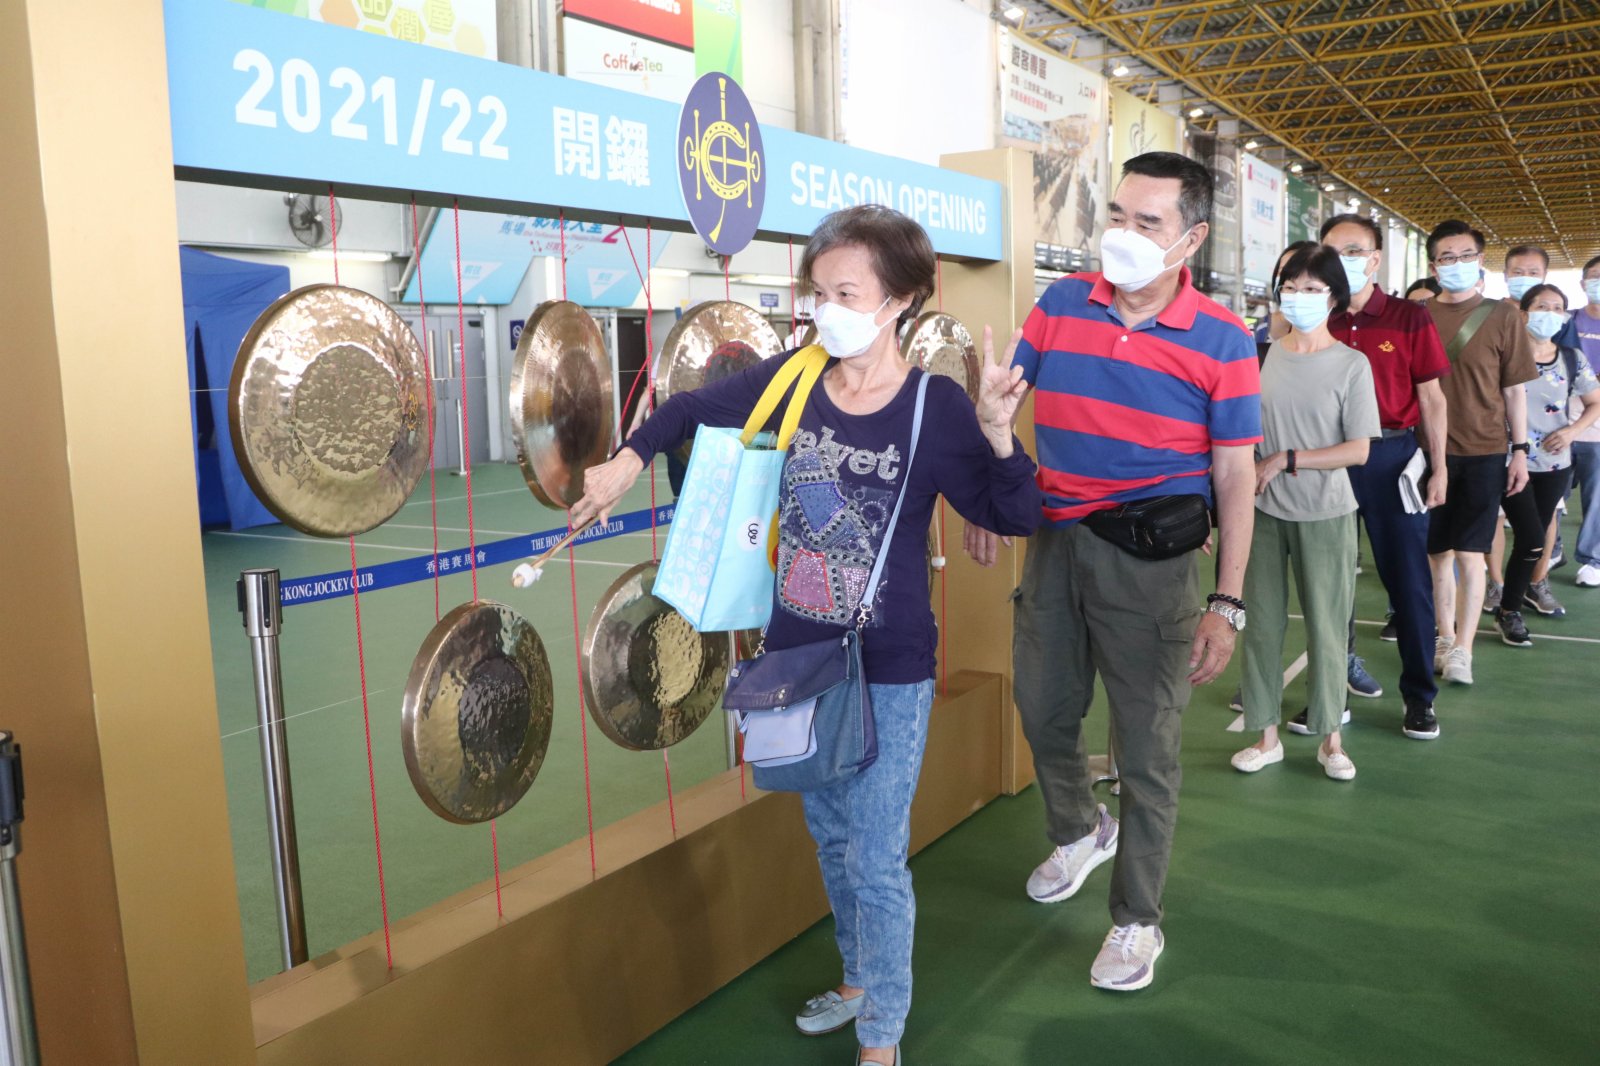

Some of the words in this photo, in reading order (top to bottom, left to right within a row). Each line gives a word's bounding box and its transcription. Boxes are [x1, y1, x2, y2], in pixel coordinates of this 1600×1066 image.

[232, 48, 509, 160] 2021/22
[552, 106, 651, 188] 開鑼
[790, 161, 893, 210] SEASON
[899, 183, 986, 235] OPENING
[531, 537, 545, 551] THE
[608, 520, 624, 533] CLUB
[426, 550, 486, 574] 香港賽馬會
[285, 583, 312, 601] KONG
[313, 577, 349, 596] JOCKEY
[350, 573, 374, 589] CLUB
